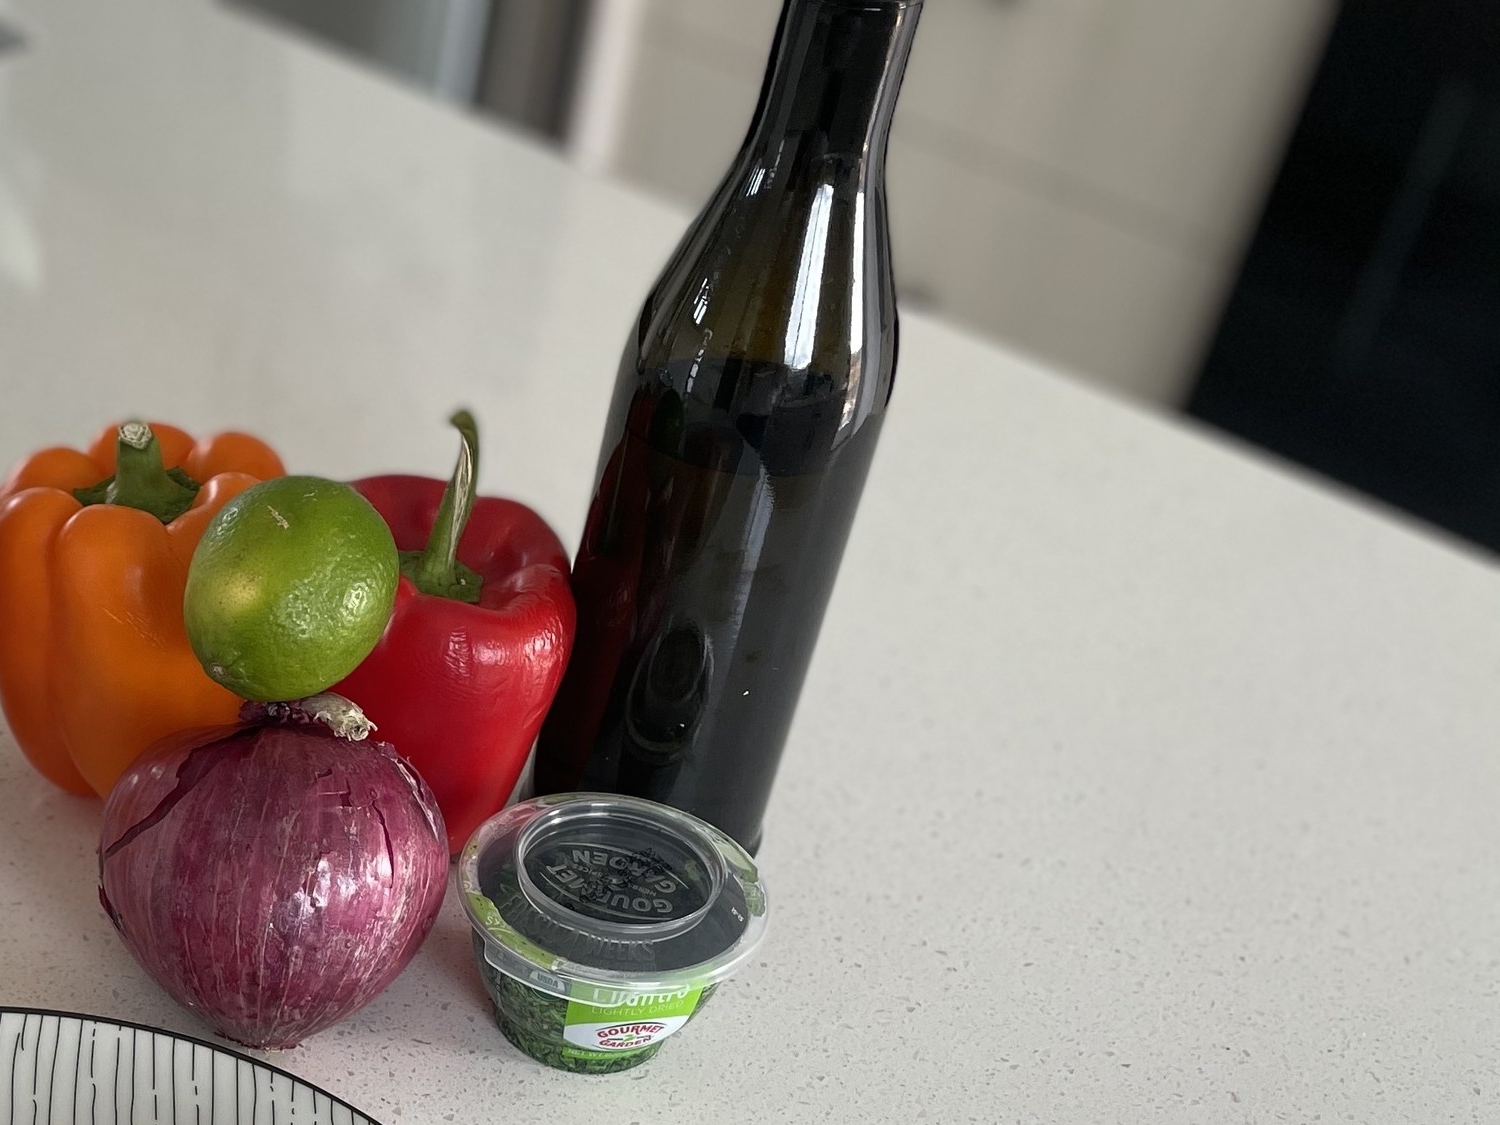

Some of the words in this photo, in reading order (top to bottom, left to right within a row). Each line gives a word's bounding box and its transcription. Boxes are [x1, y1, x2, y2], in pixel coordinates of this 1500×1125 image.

[592, 1005, 646, 1016] LIGHTLY
[649, 999, 685, 1014] DRIED
[597, 1022, 665, 1039] GOURMET
[599, 1035, 652, 1048] GARDEN
